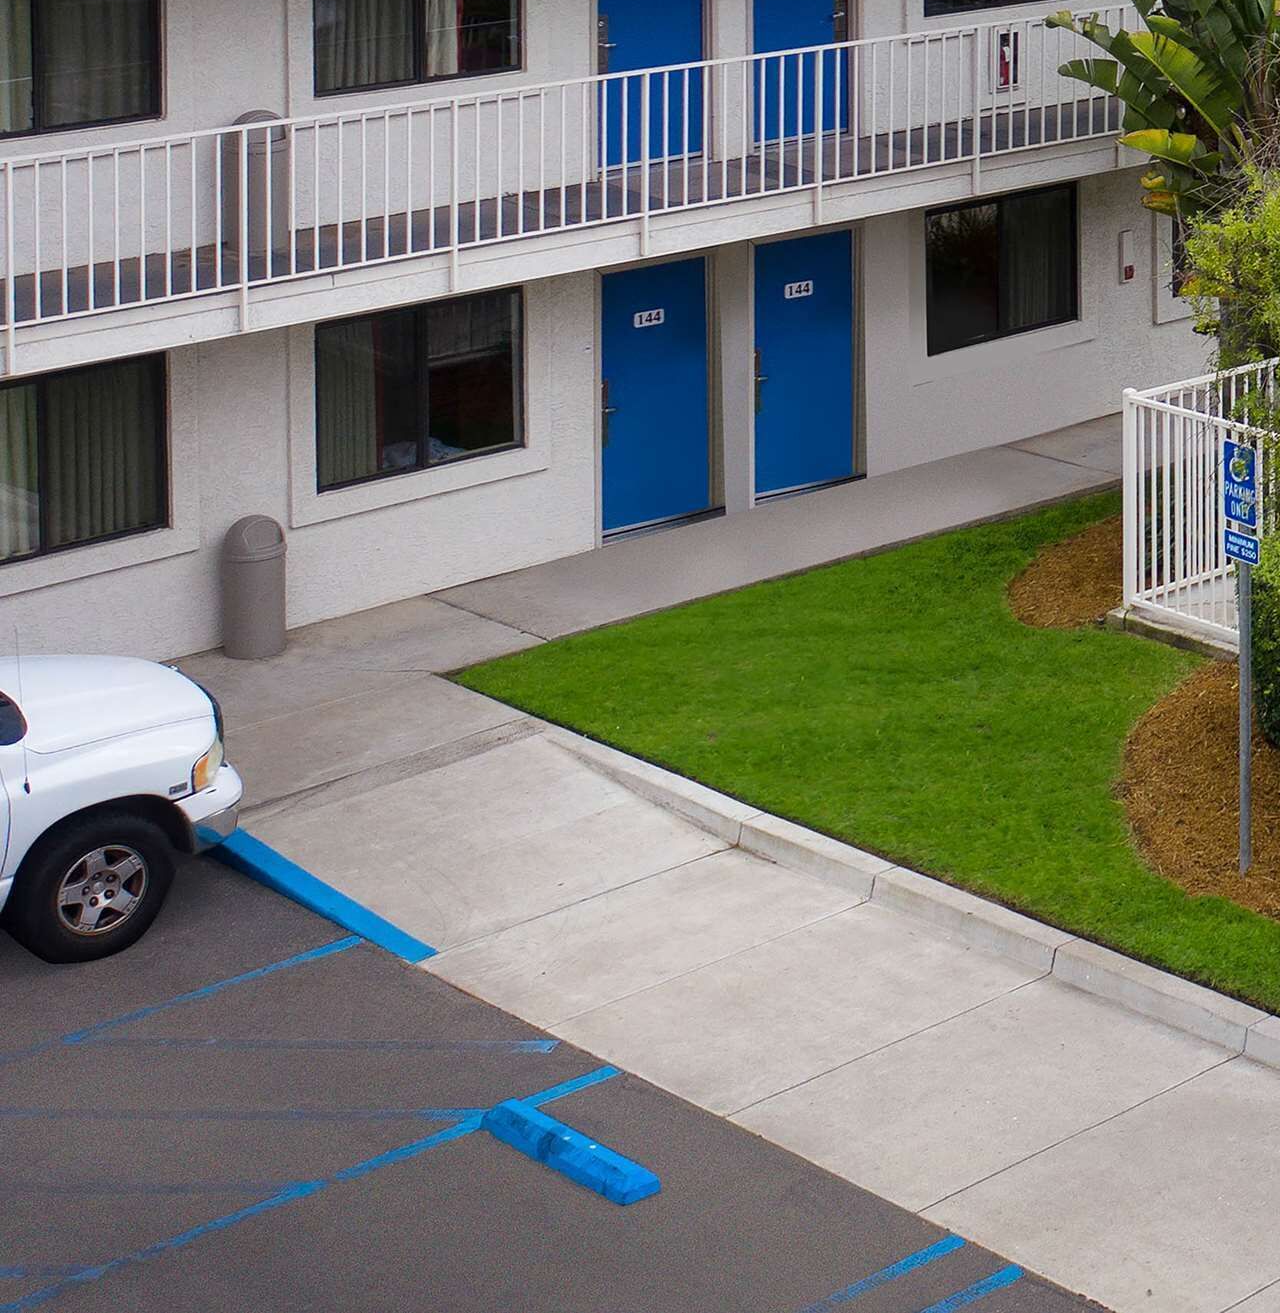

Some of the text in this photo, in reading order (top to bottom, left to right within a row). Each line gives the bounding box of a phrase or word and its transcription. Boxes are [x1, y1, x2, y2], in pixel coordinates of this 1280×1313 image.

[788, 281, 811, 297] 144
[637, 310, 662, 326] 144
[1225, 480, 1256, 504] PARKING
[1240, 546, 1257, 560] $250
